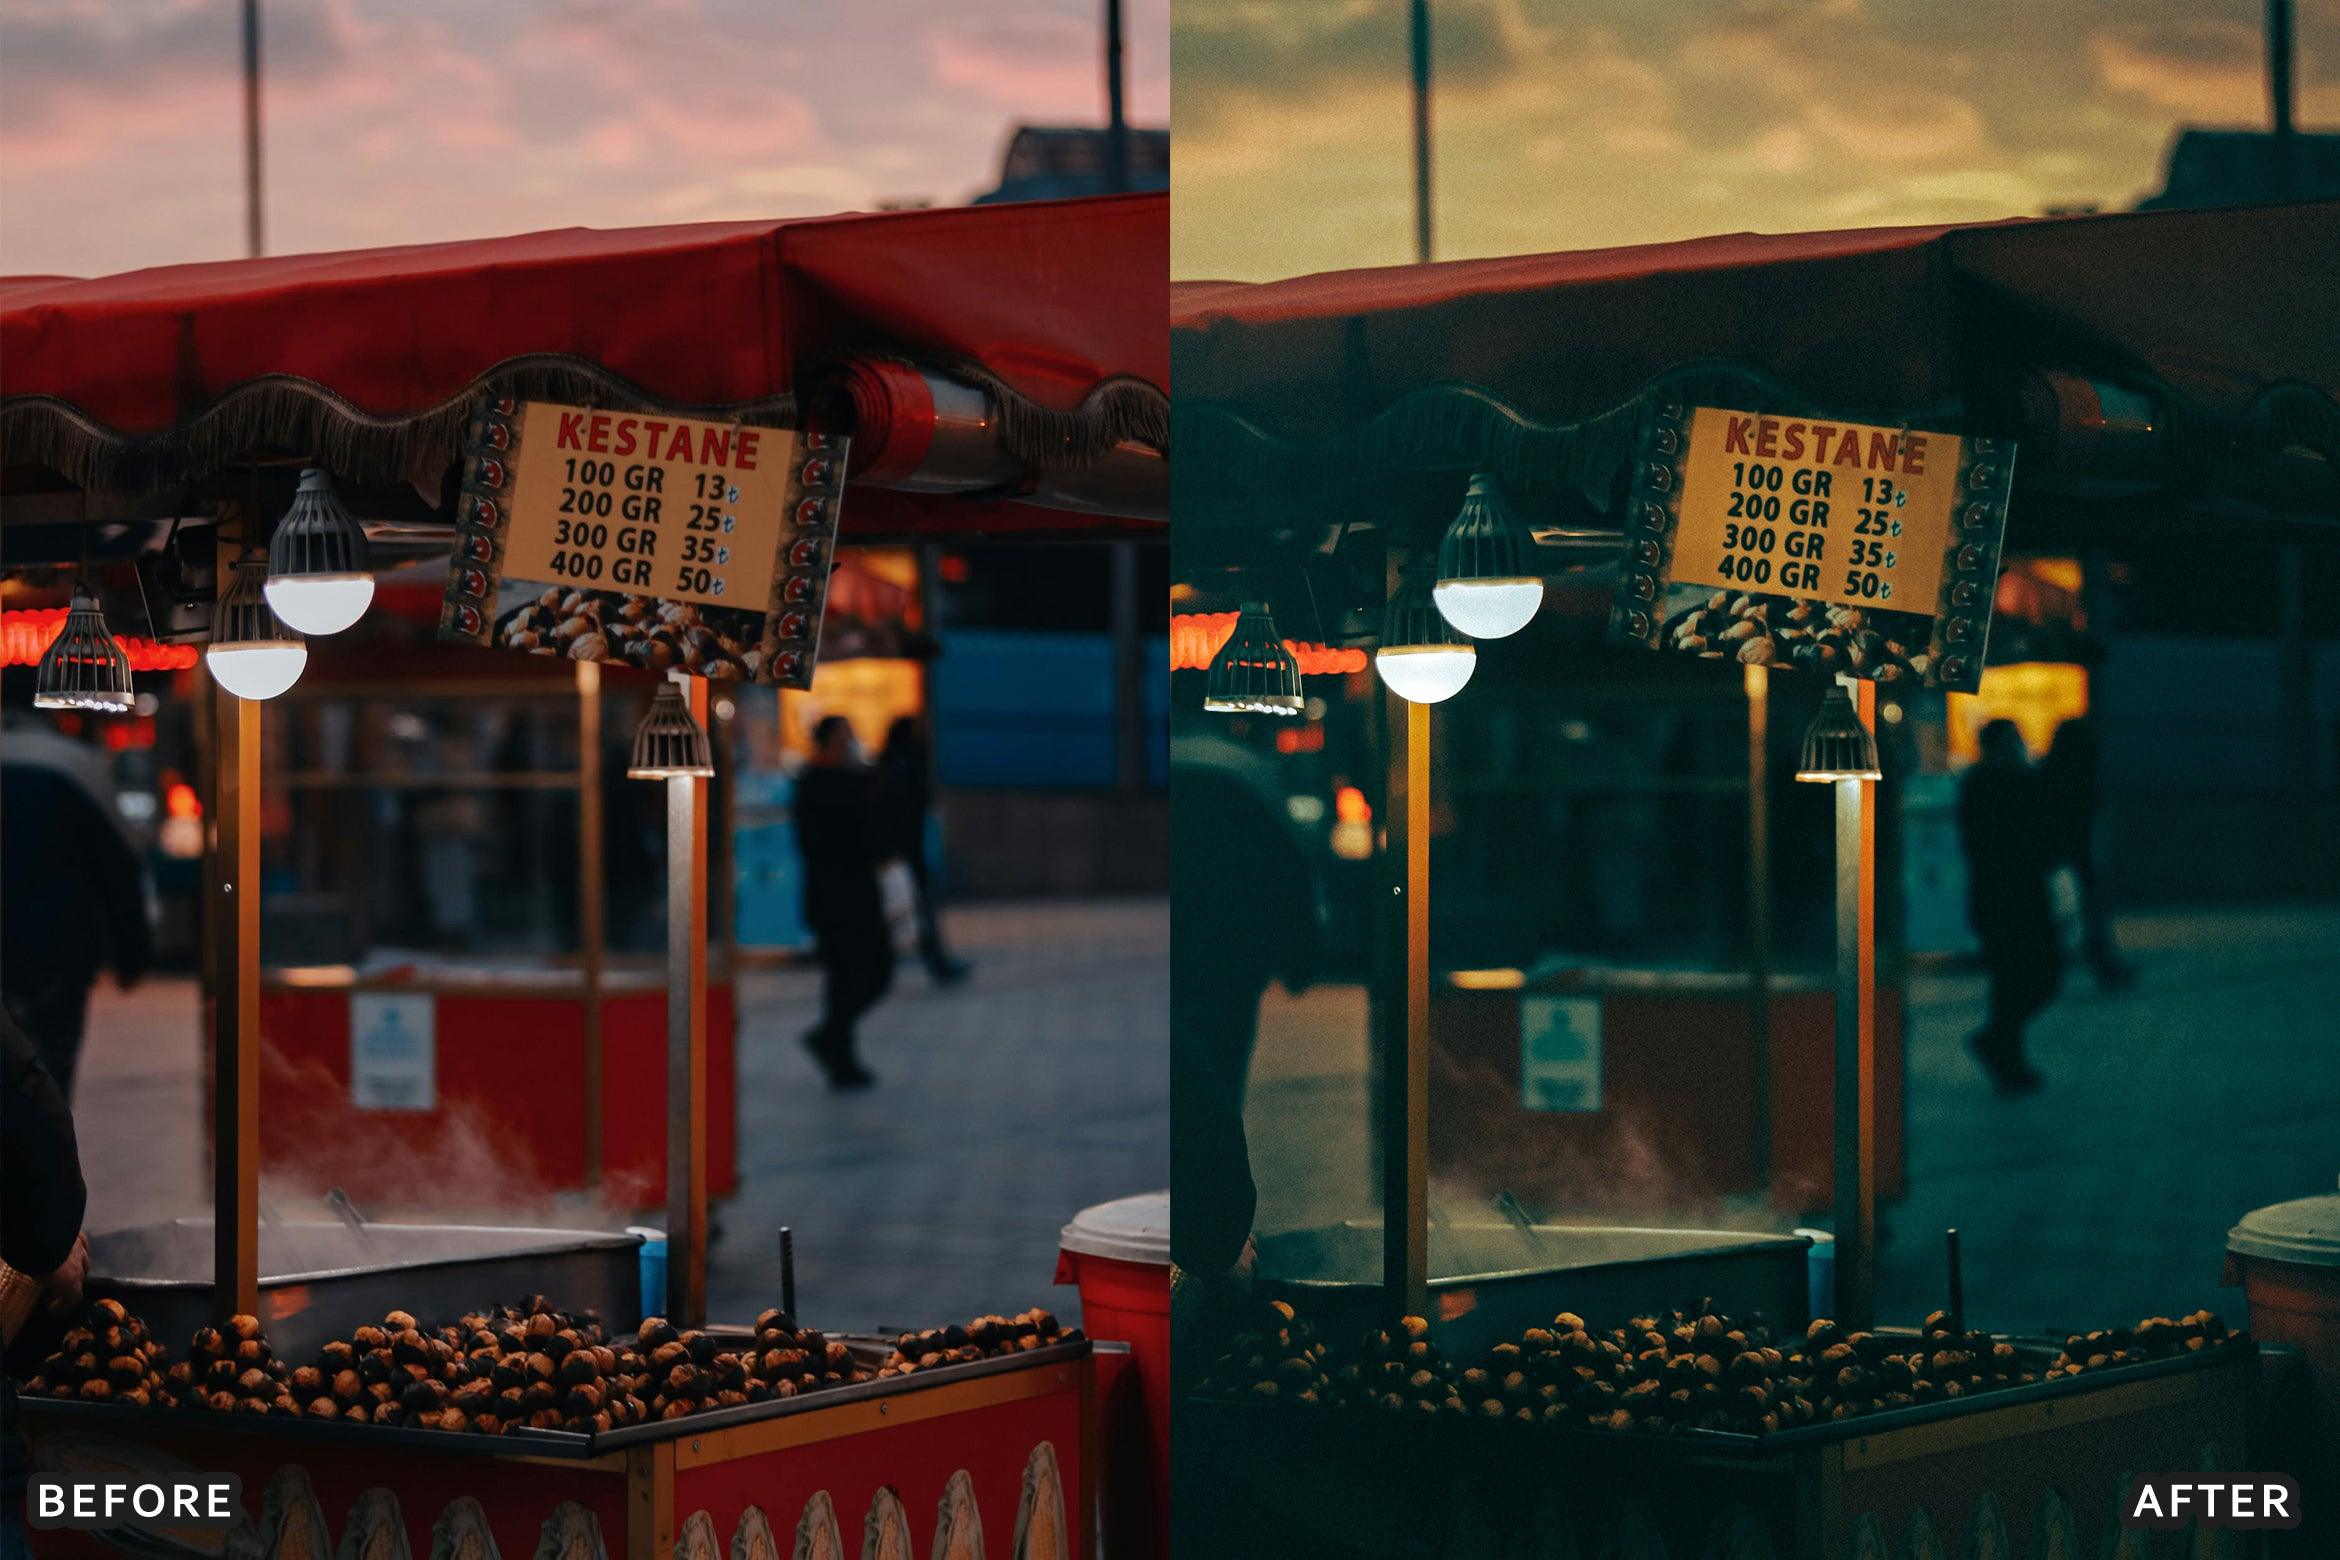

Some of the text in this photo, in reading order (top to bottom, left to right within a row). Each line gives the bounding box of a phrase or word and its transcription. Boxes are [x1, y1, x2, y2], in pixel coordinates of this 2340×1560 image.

[557, 412, 760, 470] KESTANE
[1725, 416, 1928, 476] KESTANE
[565, 458, 615, 487] 100
[624, 465, 665, 493] GR
[1733, 463, 1783, 492] 100
[1792, 469, 1833, 498] GR
[559, 488, 612, 517] 200
[621, 495, 662, 524] GR
[1727, 492, 1780, 522] 200
[1789, 499, 1830, 528] GR
[554, 519, 607, 549] 300
[616, 527, 657, 556] GR
[1722, 524, 1775, 553] 300
[1784, 531, 1825, 560] GR
[550, 551, 603, 580] 400
[612, 557, 652, 587] GR
[1718, 555, 1771, 584] 400
[1780, 561, 1820, 591] GR
